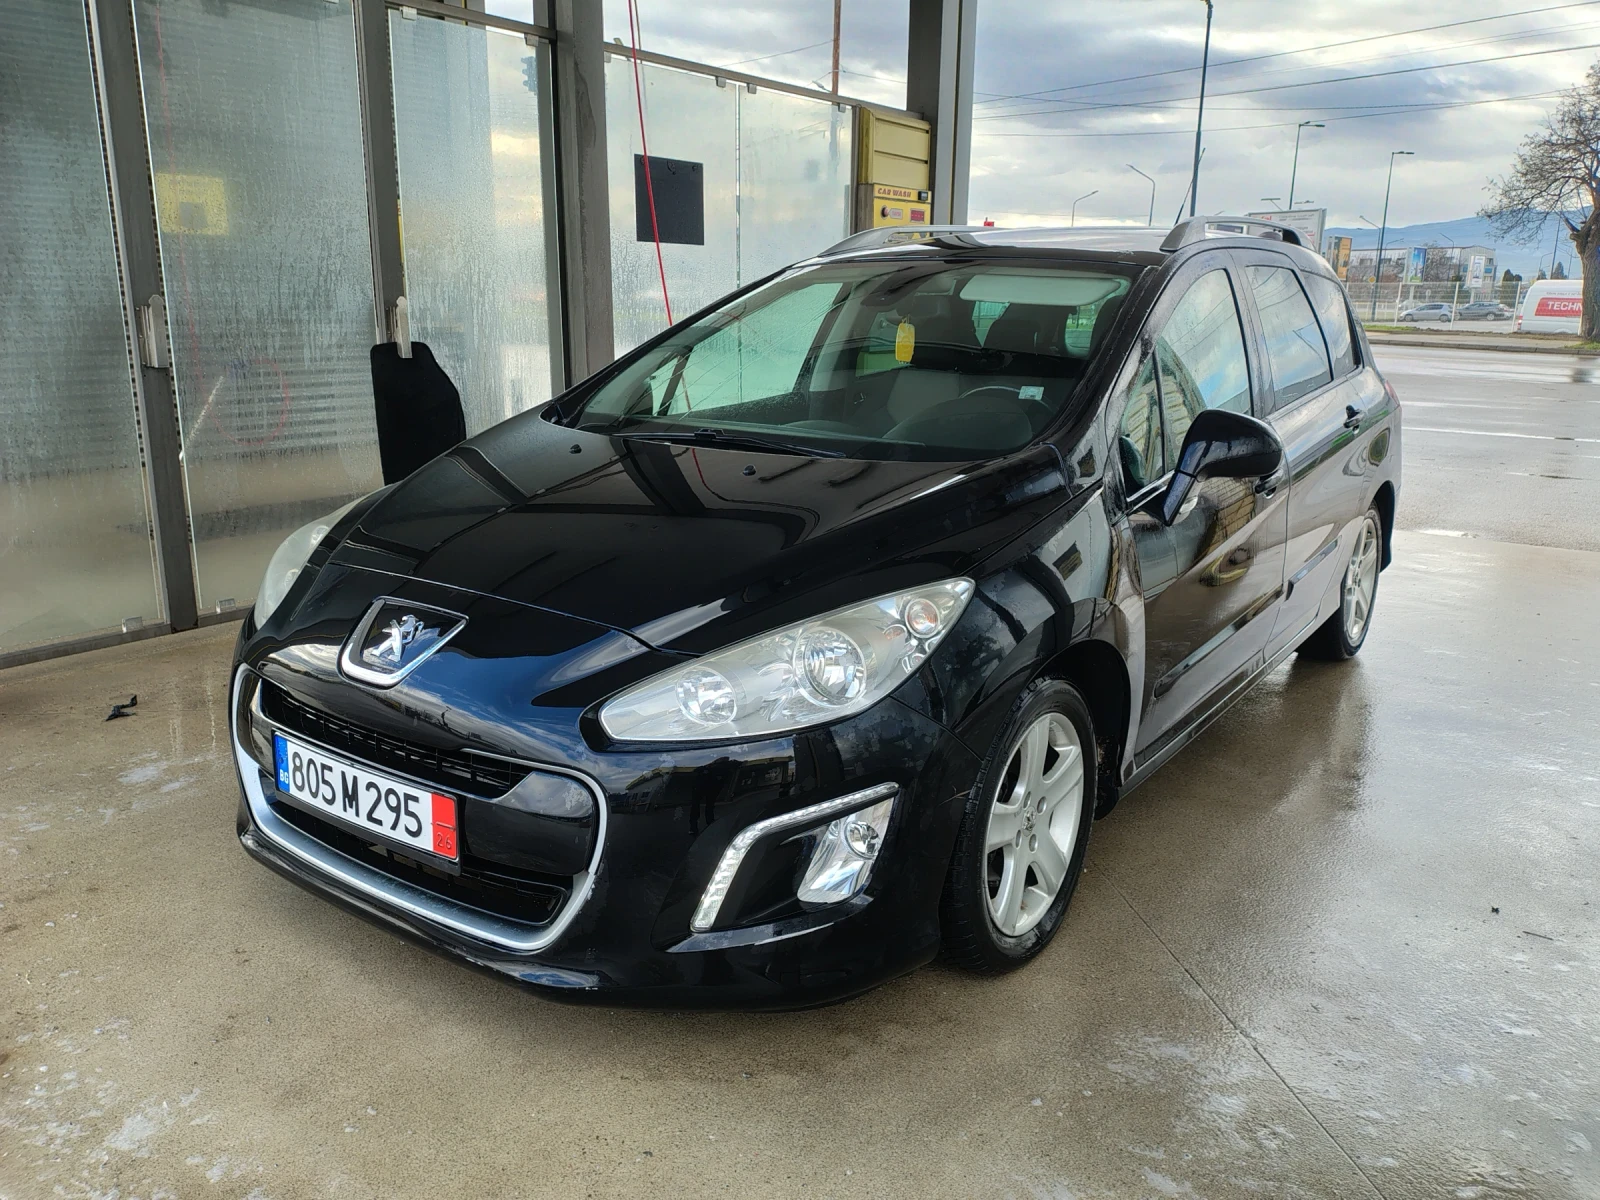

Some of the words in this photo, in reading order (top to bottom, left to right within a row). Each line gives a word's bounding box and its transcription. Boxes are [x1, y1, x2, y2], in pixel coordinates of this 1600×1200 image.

[877, 188, 891, 196] CAR
[892, 189, 911, 198] WASH
[280, 769, 289, 784] BG
[292, 751, 336, 806] 805
[341, 770, 360, 818] M
[365, 781, 422, 838] 295
[437, 831, 452, 850] 26
